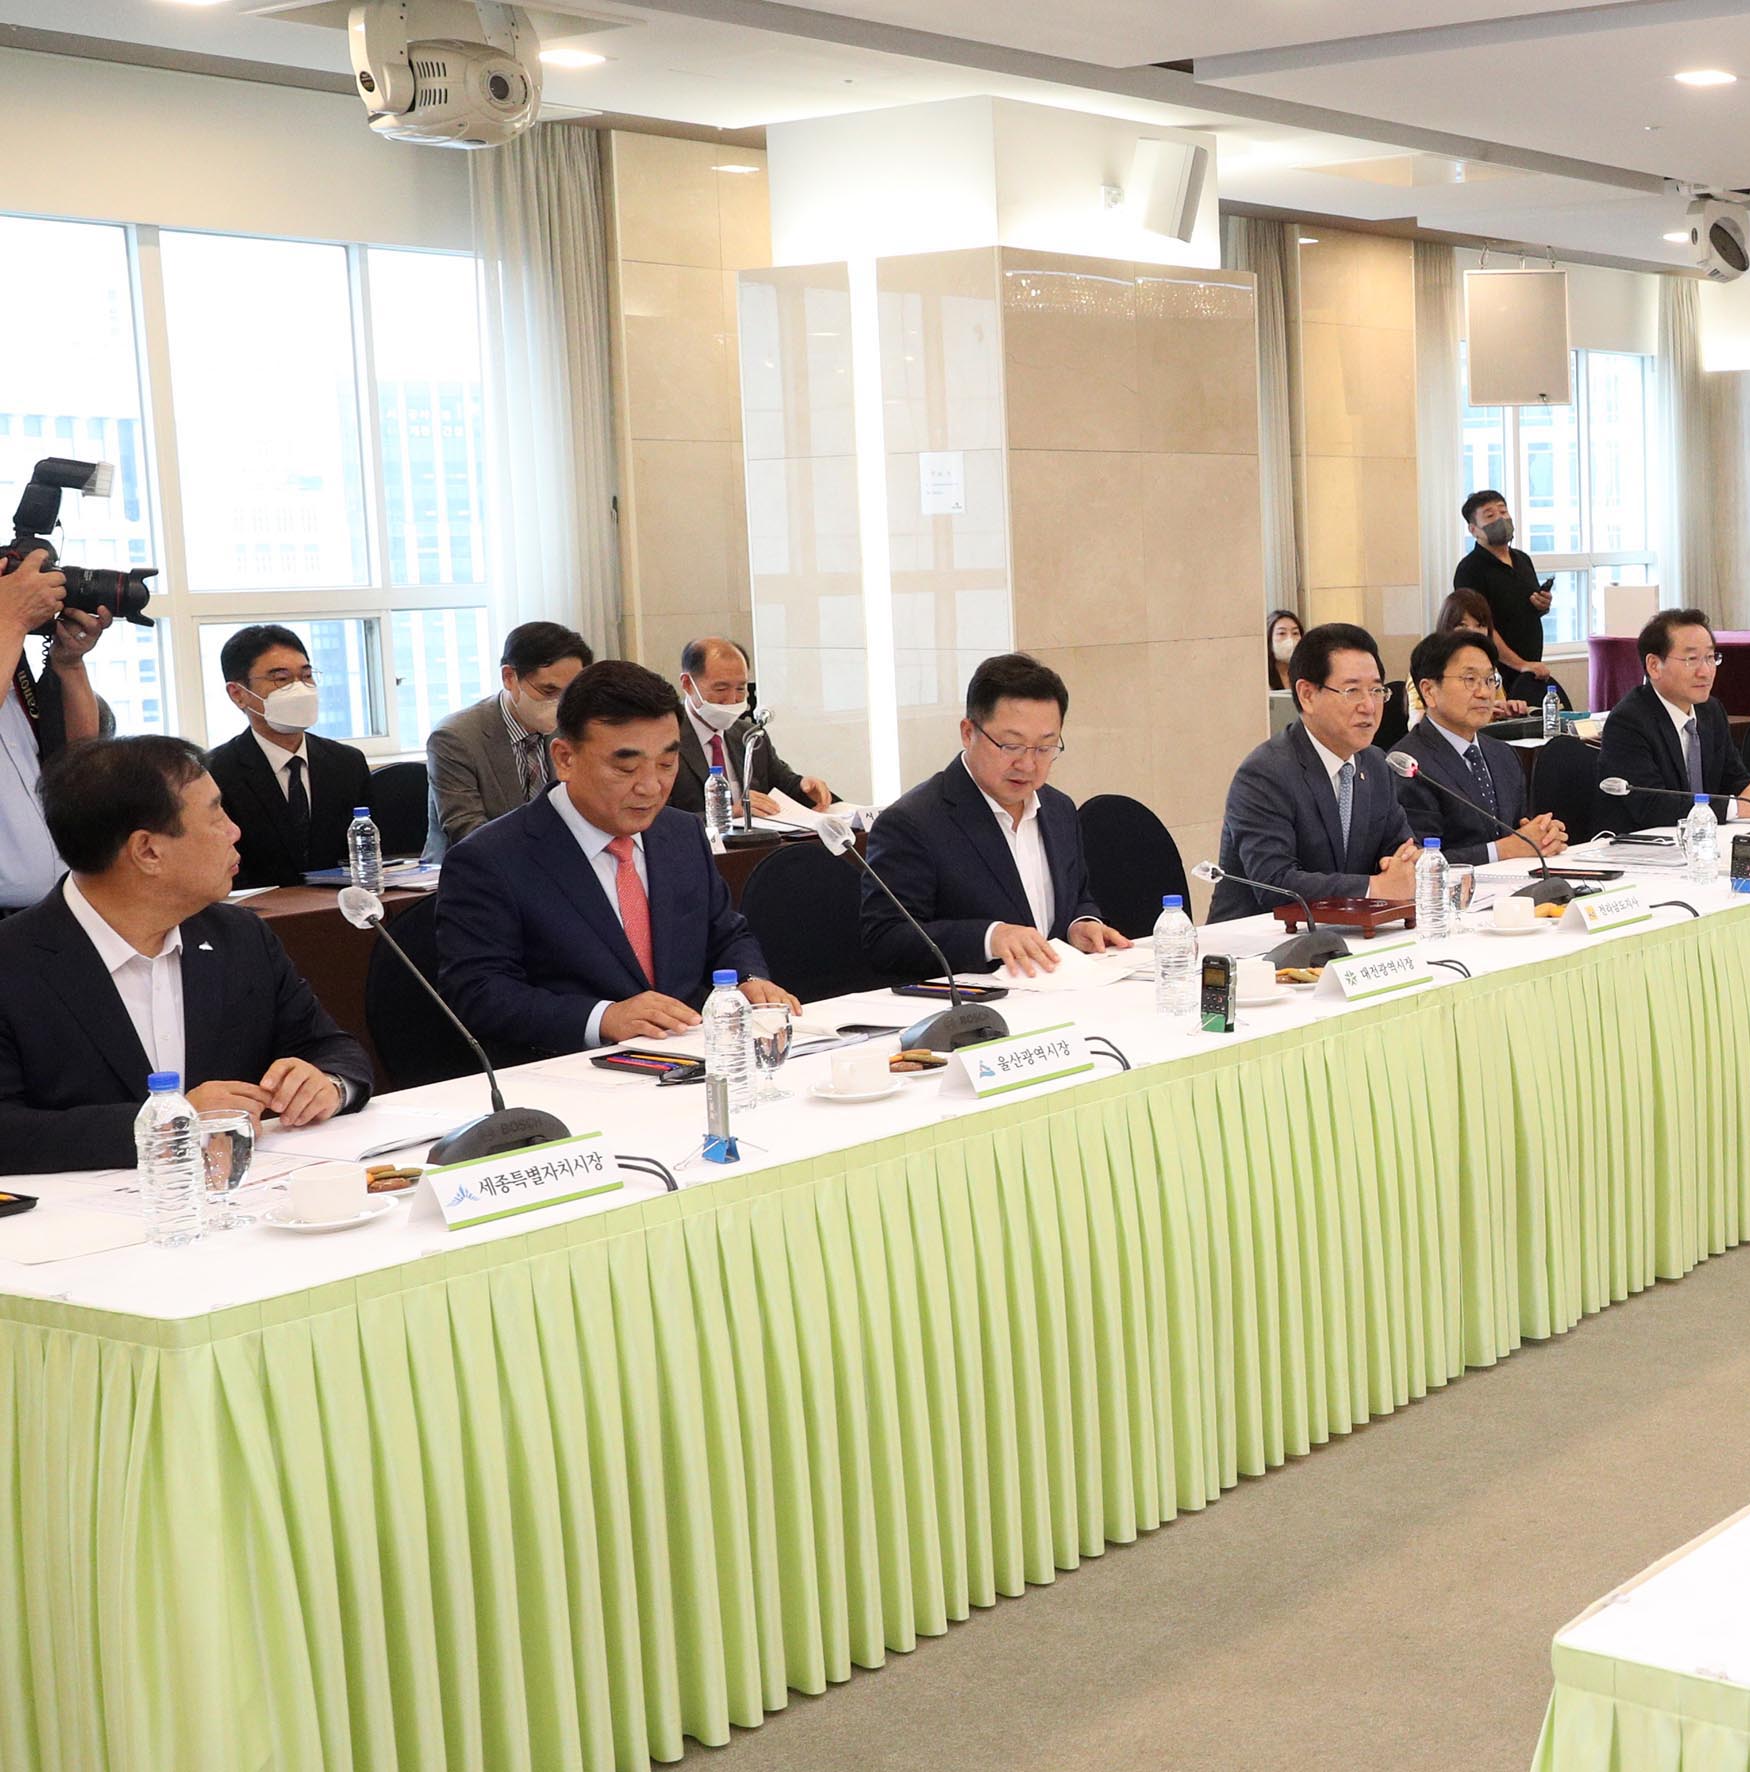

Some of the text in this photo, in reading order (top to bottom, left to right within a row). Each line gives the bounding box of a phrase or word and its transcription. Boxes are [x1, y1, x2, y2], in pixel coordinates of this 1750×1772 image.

[1598, 896, 1640, 916] 전라남도지사
[1360, 956, 1415, 981] 대전광역시장
[997, 1040, 1071, 1072] 울산광역시장
[479, 1151, 604, 1197] 세종특별자치시장
